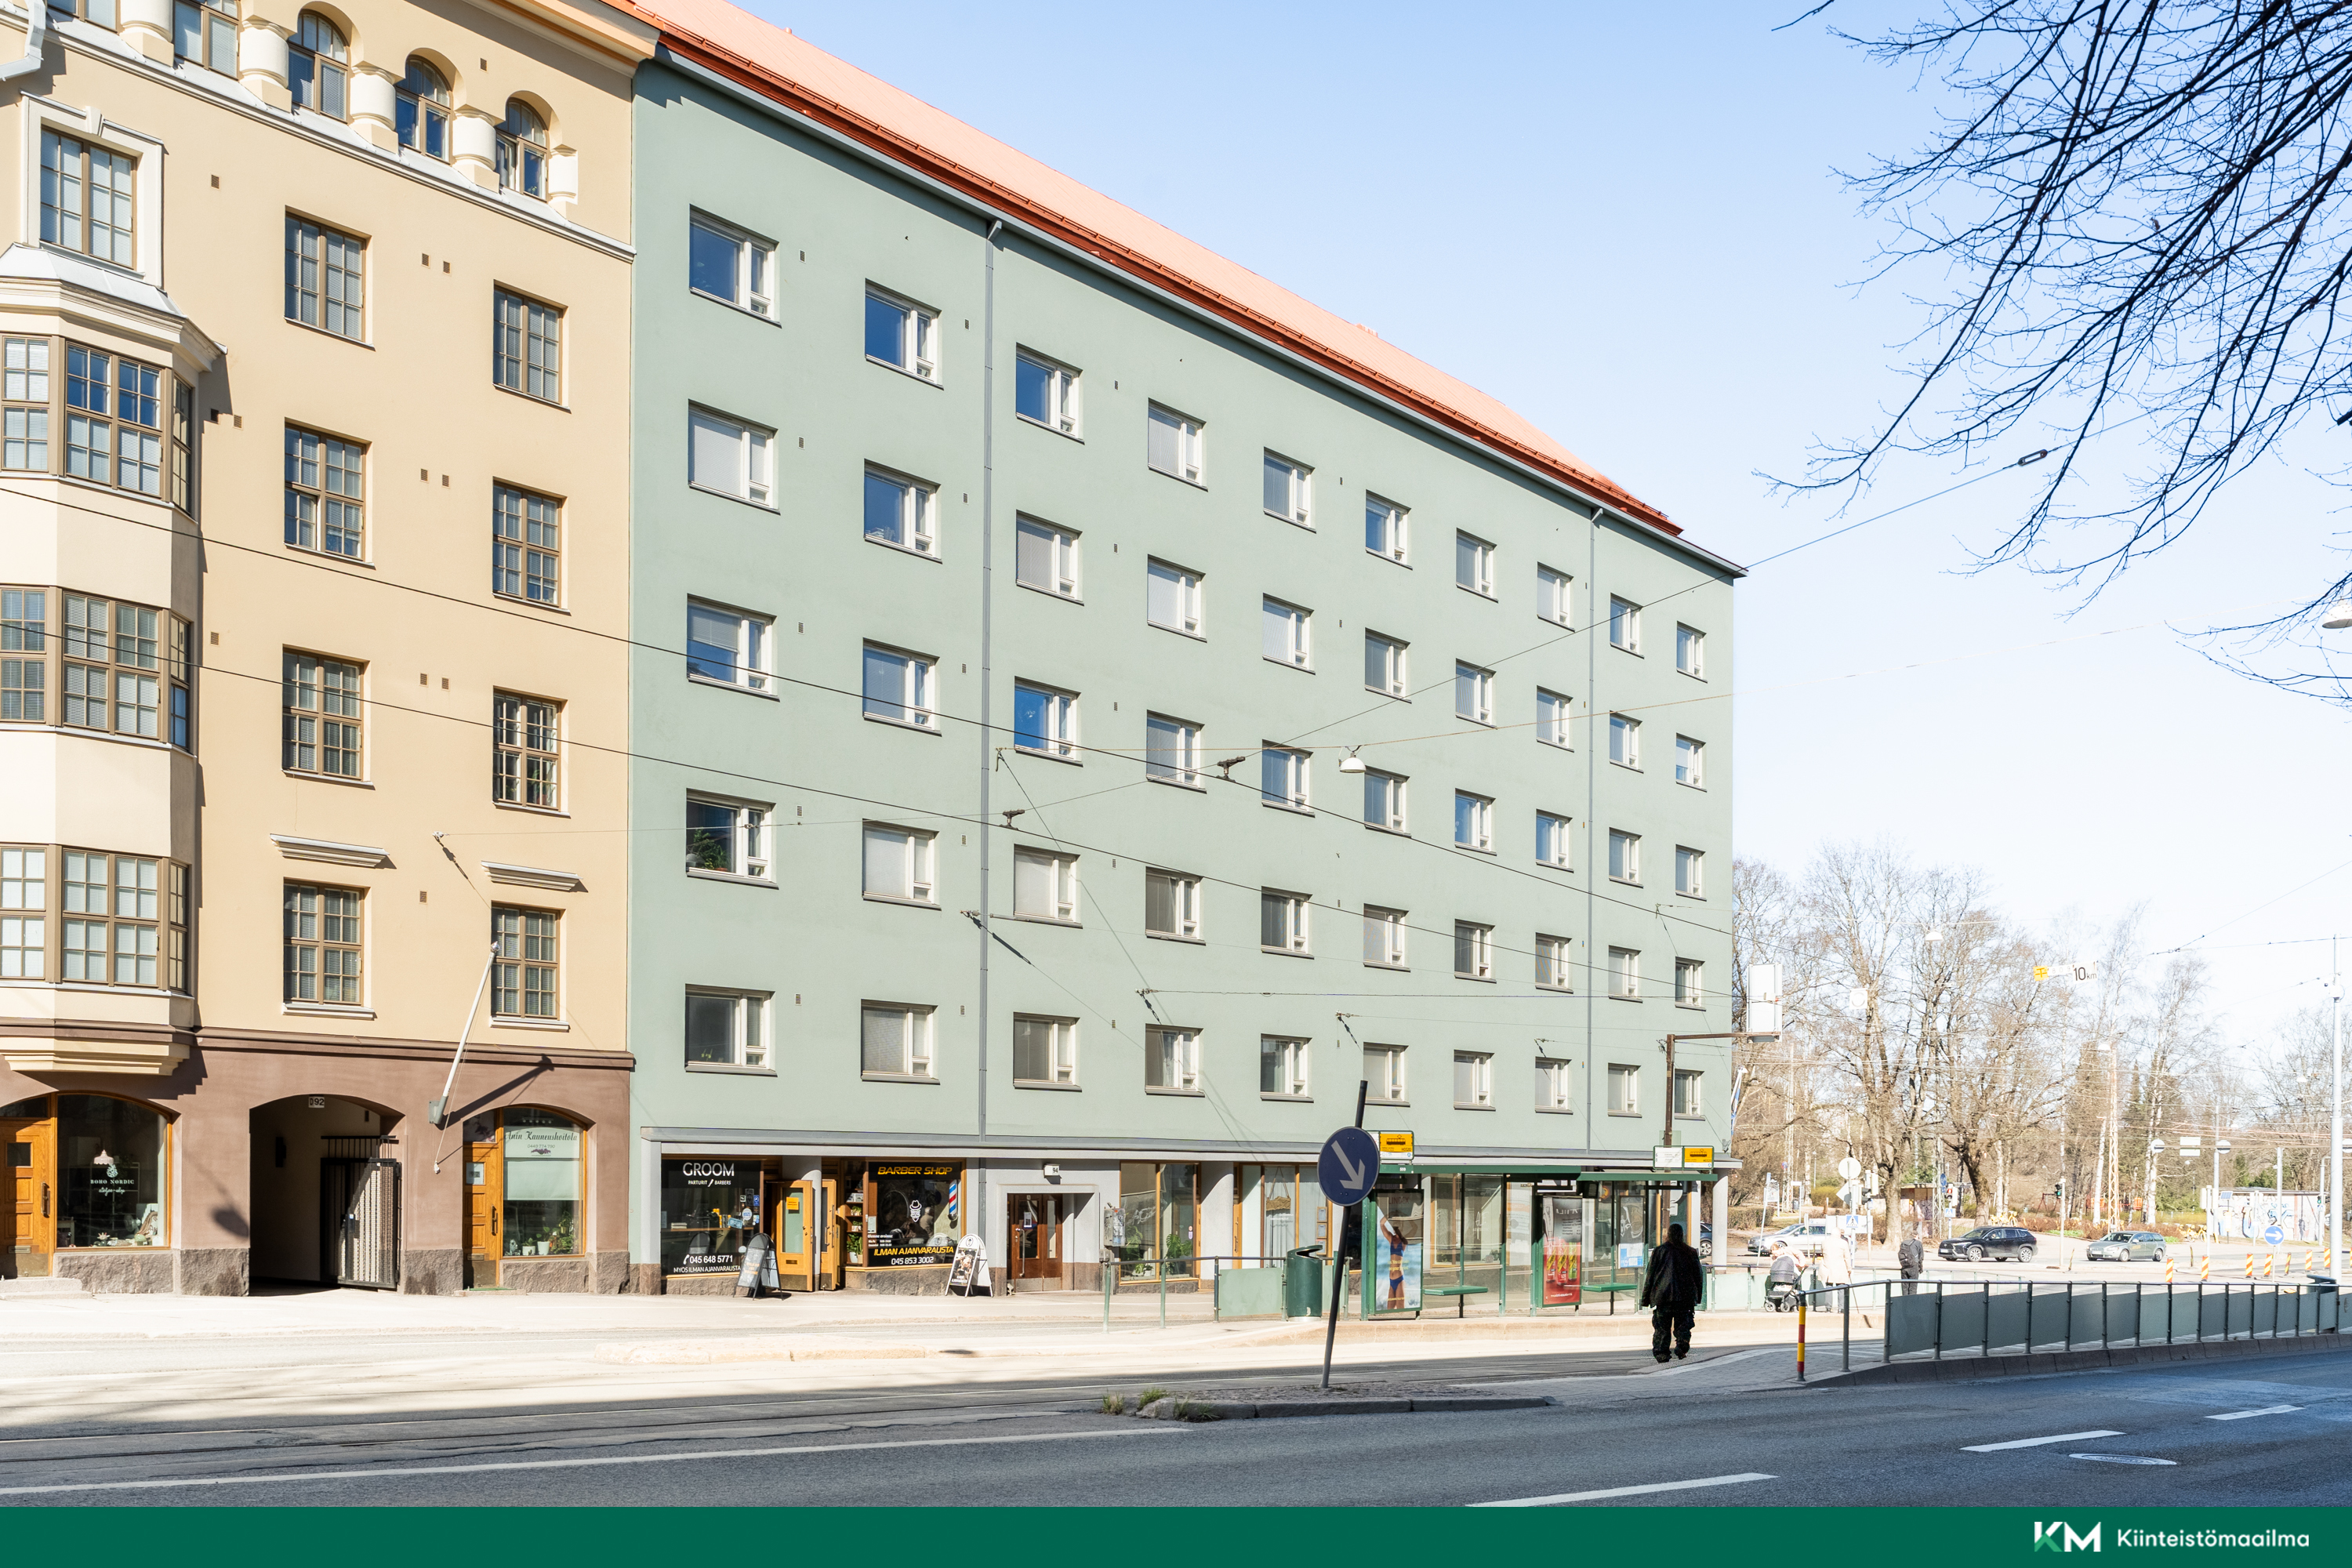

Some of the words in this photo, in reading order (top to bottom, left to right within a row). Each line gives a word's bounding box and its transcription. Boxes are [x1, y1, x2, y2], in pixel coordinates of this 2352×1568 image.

[683, 1163, 735, 1176] GROOM
[690, 1255, 702, 1264] 045
[717, 1254, 733, 1263] 5771
